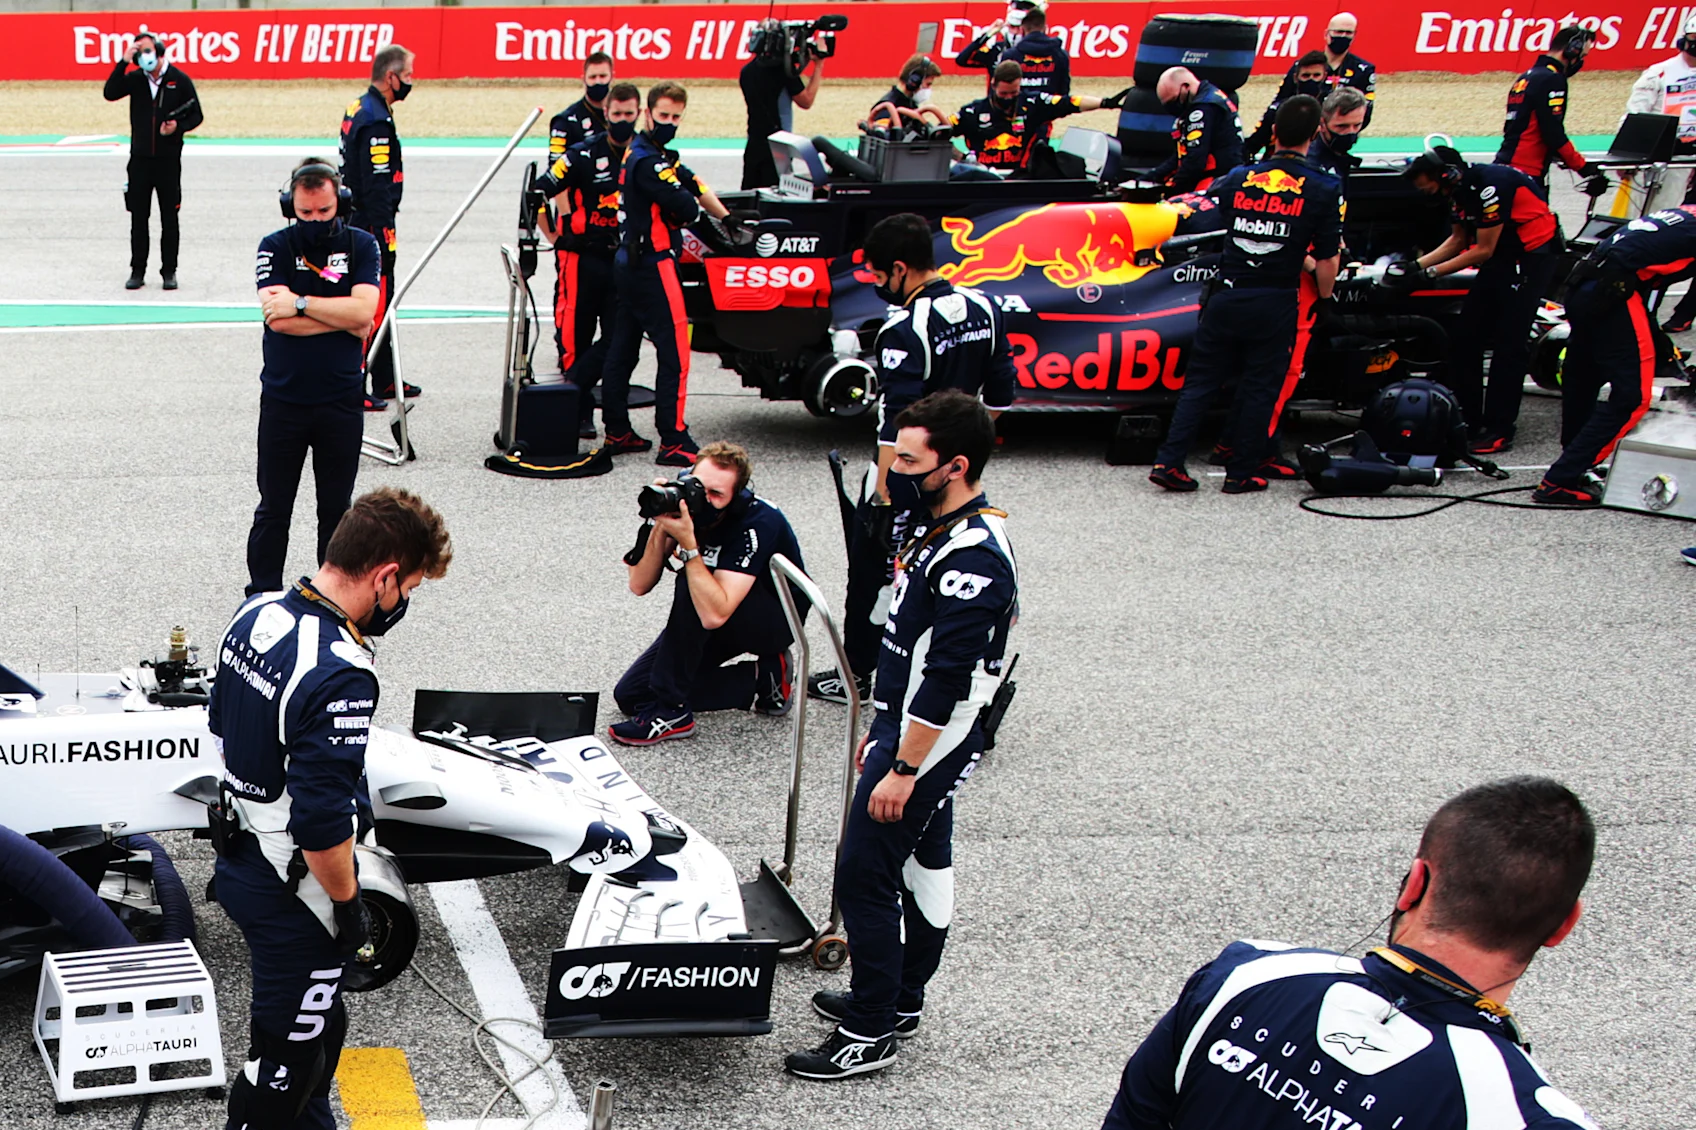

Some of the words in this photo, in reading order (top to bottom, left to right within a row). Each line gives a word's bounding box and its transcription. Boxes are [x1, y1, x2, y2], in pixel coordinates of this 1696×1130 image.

[73, 23, 241, 64] Emates
[254, 24, 297, 63] FLY
[301, 23, 394, 63] BETTER
[496, 20, 672, 61] Emirates
[685, 20, 735, 60] FLY
[940, 19, 1130, 59] Eates
[1415, 7, 1623, 53] Emirates
[1233, 191, 1265, 212] Red
[1266, 194, 1305, 217] Bull
[1234, 217, 1274, 236] Mobil
[780, 237, 819, 253] AT&T
[725, 266, 815, 289] ESSO
[1006, 332, 1112, 391] Red
[1119, 329, 1188, 391] Bu
[109, 1036, 198, 1057] ALPHATAURI
